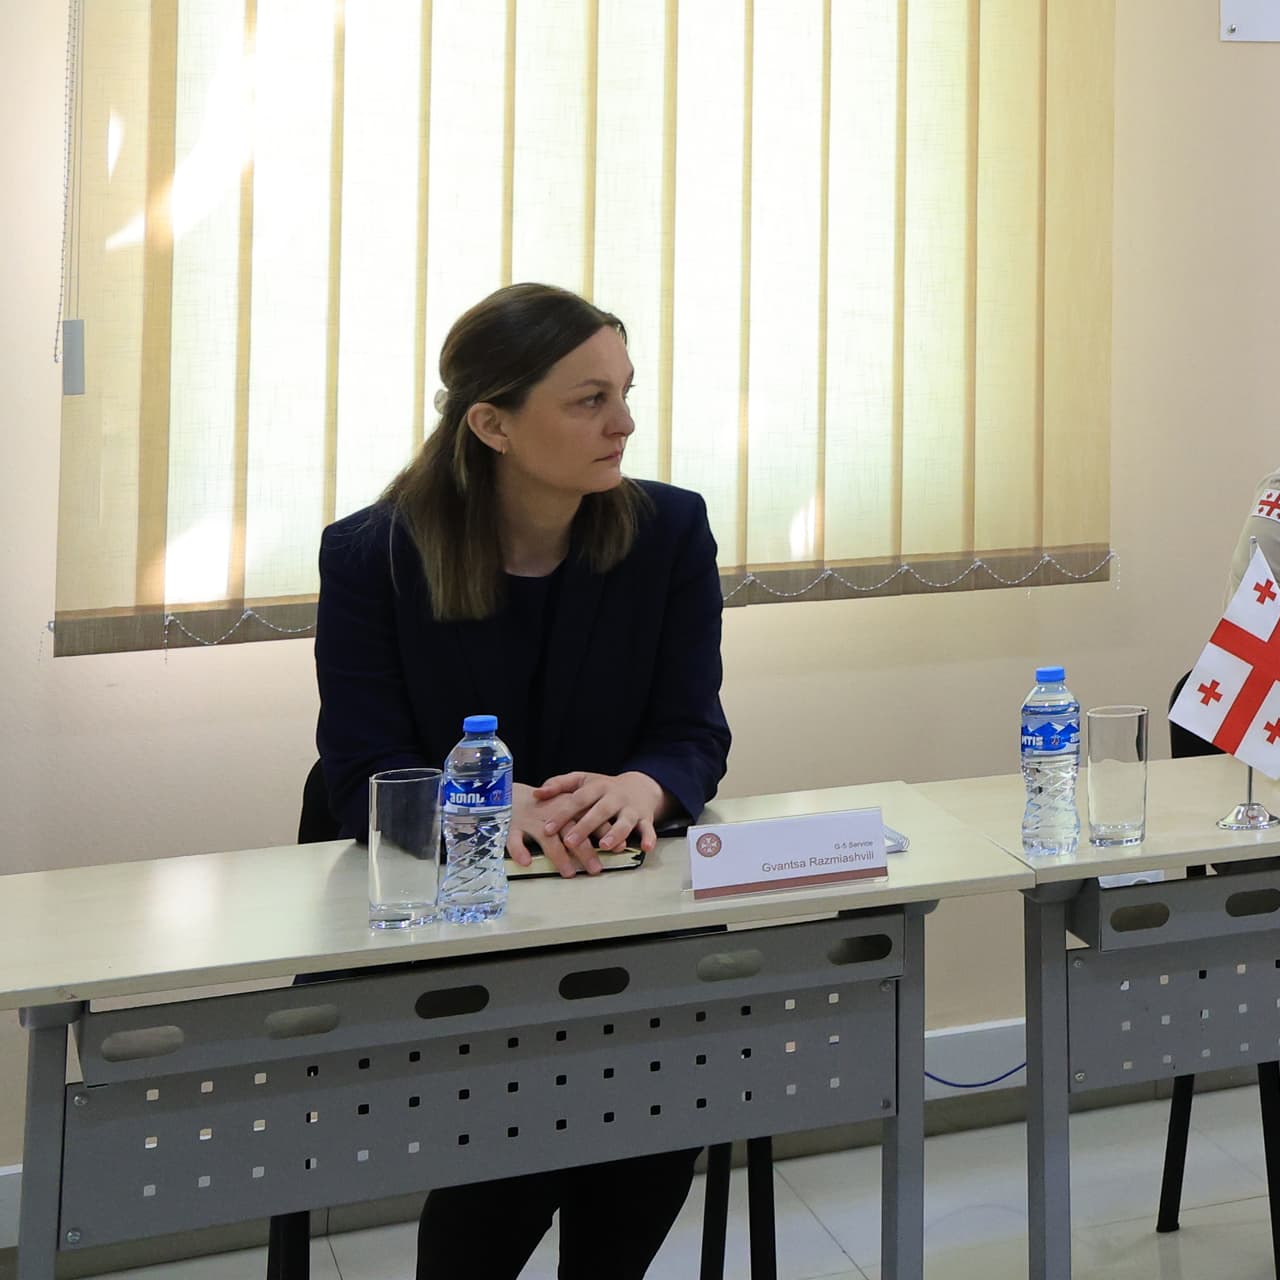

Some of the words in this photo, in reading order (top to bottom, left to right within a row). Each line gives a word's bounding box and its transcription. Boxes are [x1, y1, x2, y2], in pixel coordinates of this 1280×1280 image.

[834, 841, 847, 850] G-5
[848, 839, 873, 849] Service
[761, 858, 807, 873] Gvantsa
[809, 851, 875, 866] Razmiashvili
